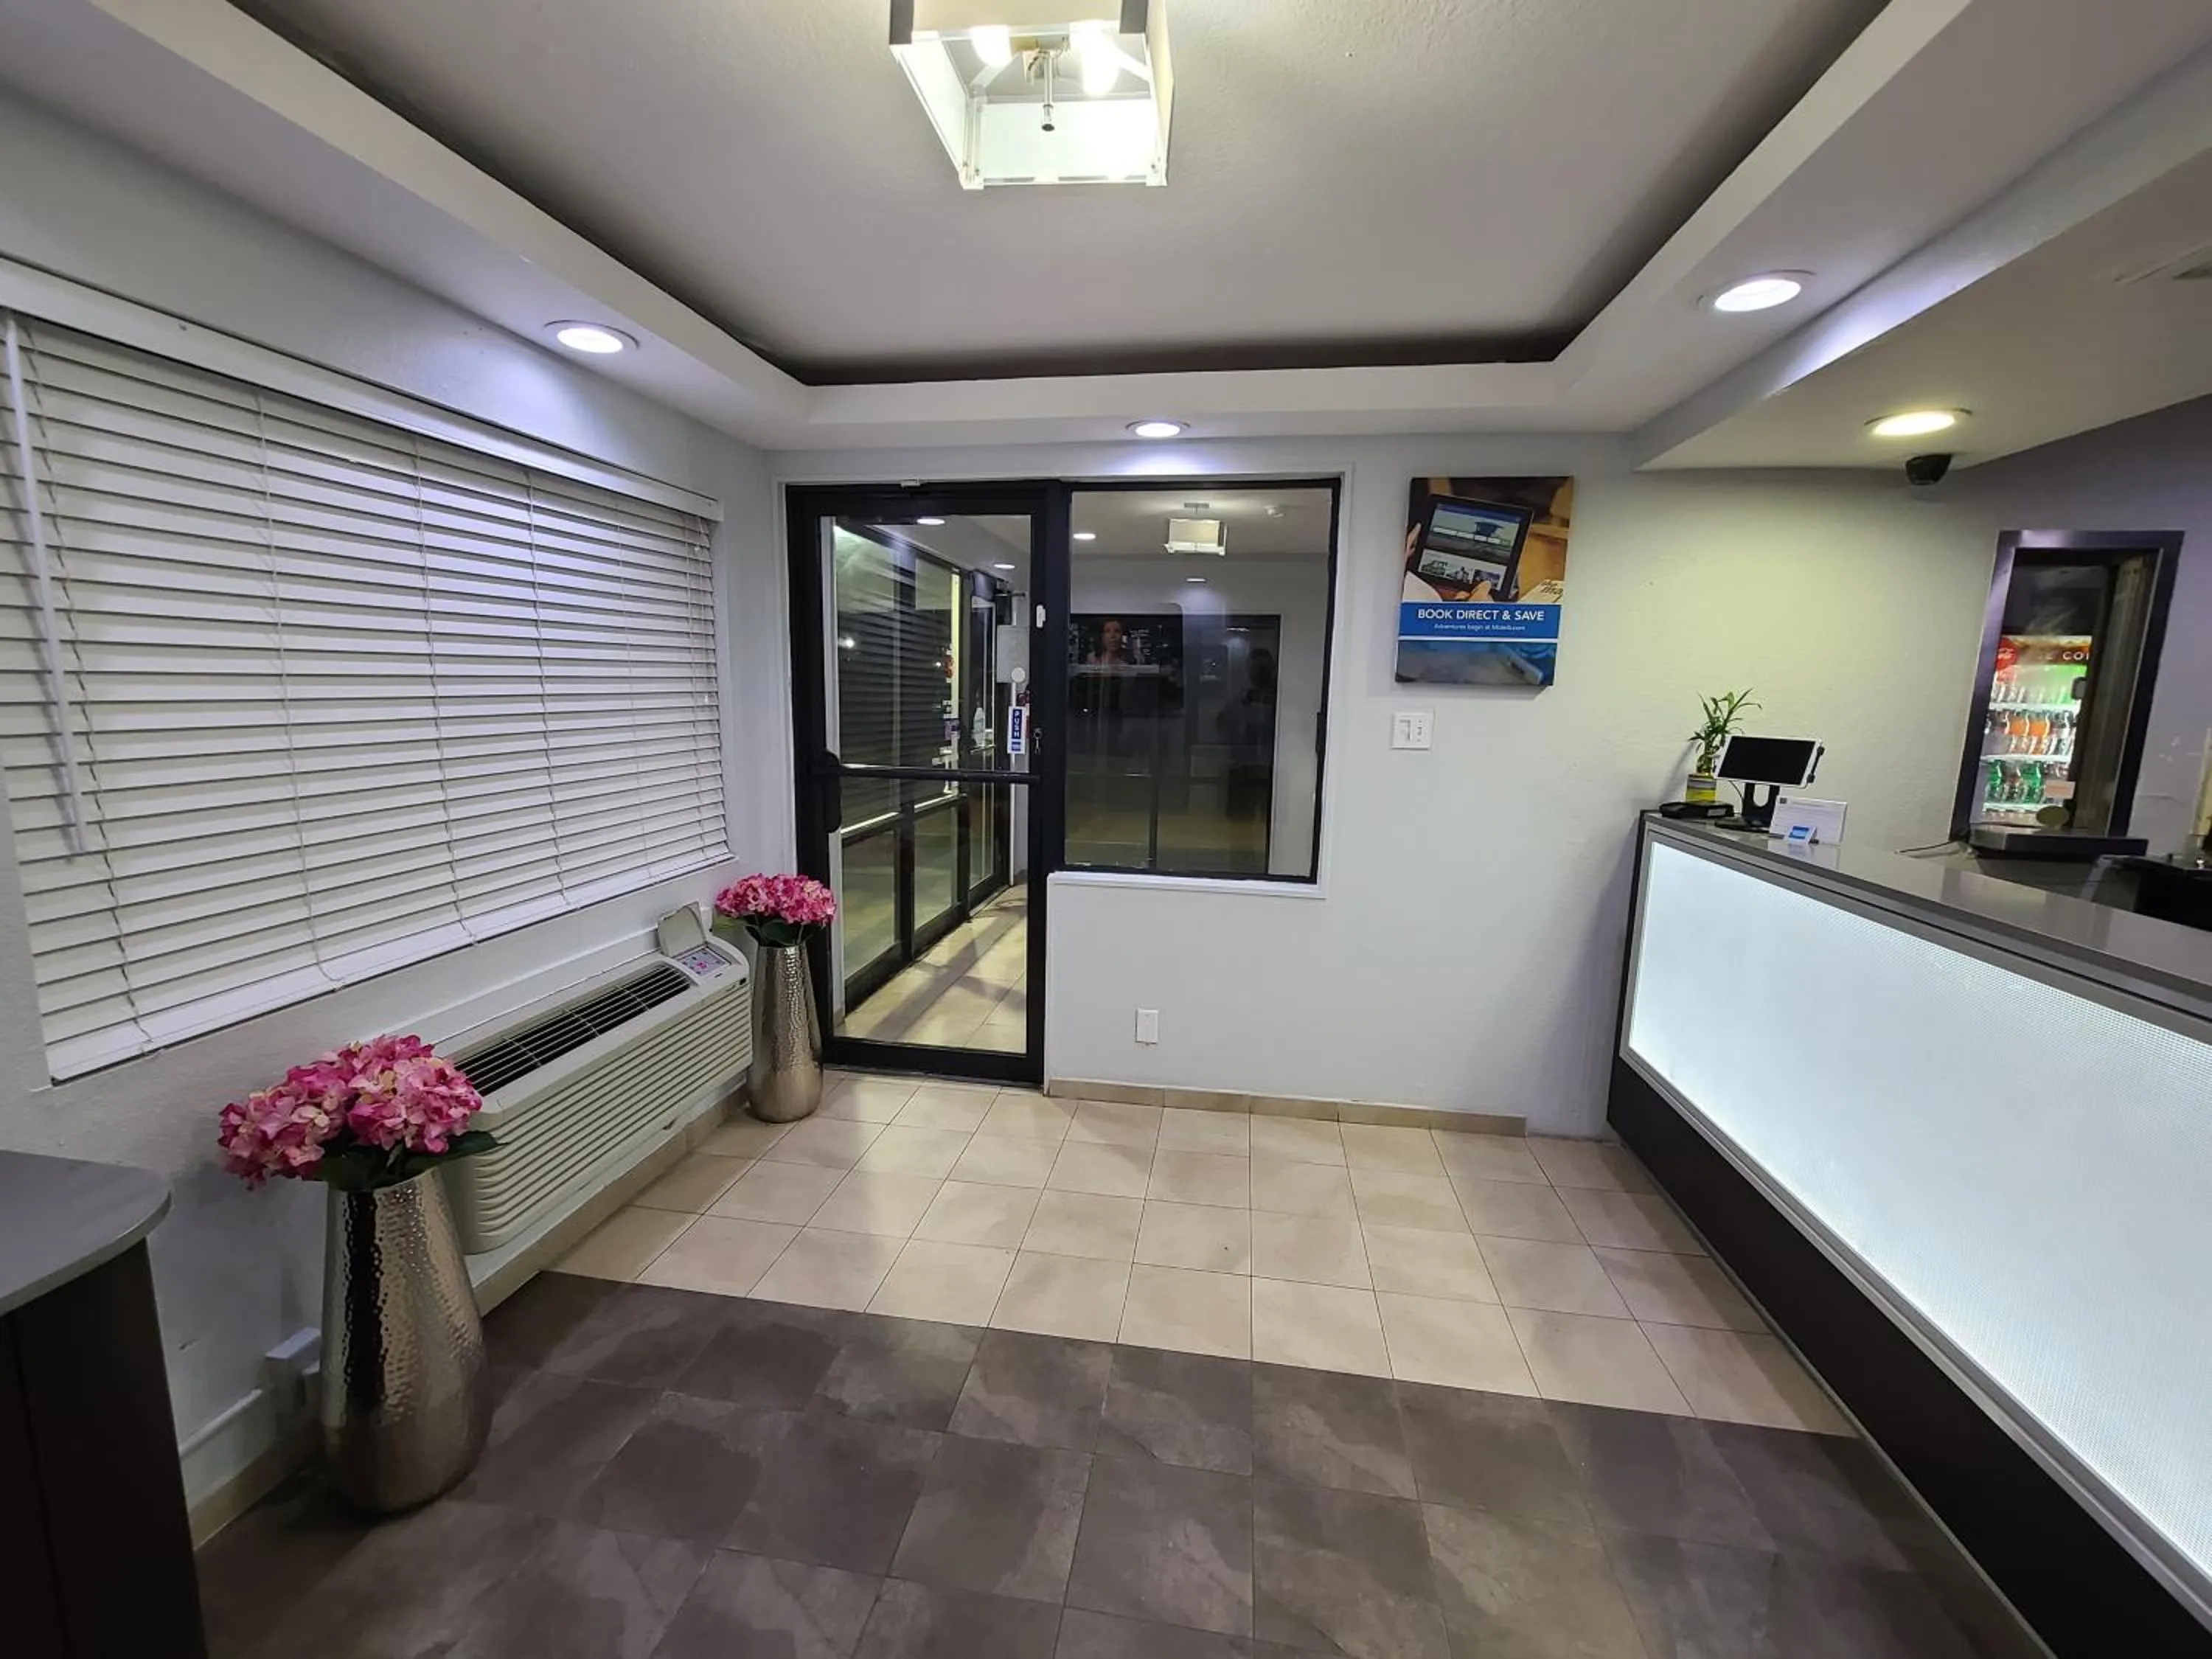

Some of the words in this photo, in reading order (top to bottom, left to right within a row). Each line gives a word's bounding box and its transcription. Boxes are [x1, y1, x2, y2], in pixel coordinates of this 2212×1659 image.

[1418, 609, 1453, 619] BOOK
[1456, 609, 1500, 620] DIRECT
[1502, 610, 1511, 620] &
[1514, 611, 1545, 621] SAVE
